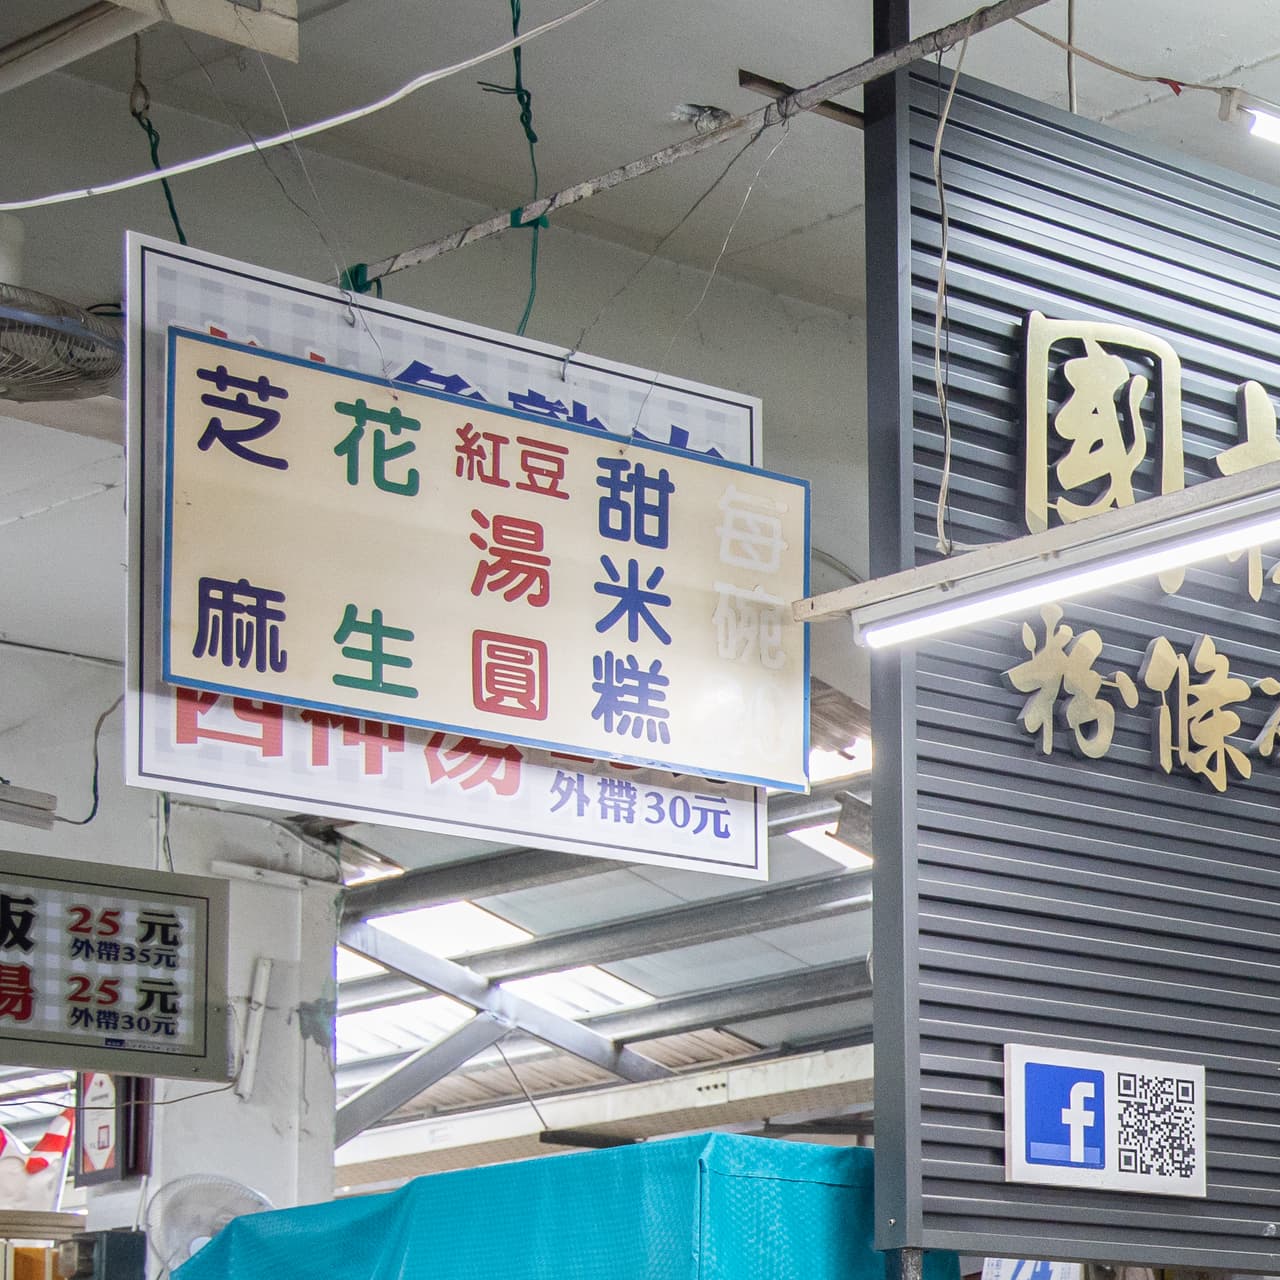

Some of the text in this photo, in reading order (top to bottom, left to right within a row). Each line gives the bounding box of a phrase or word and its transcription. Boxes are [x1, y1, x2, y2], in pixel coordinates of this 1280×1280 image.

[192, 365, 289, 673] 芝麻
[332, 399, 421, 701] 花生
[591, 457, 677, 746] 甜米糕
[550, 770, 731, 839] 外帶30元
